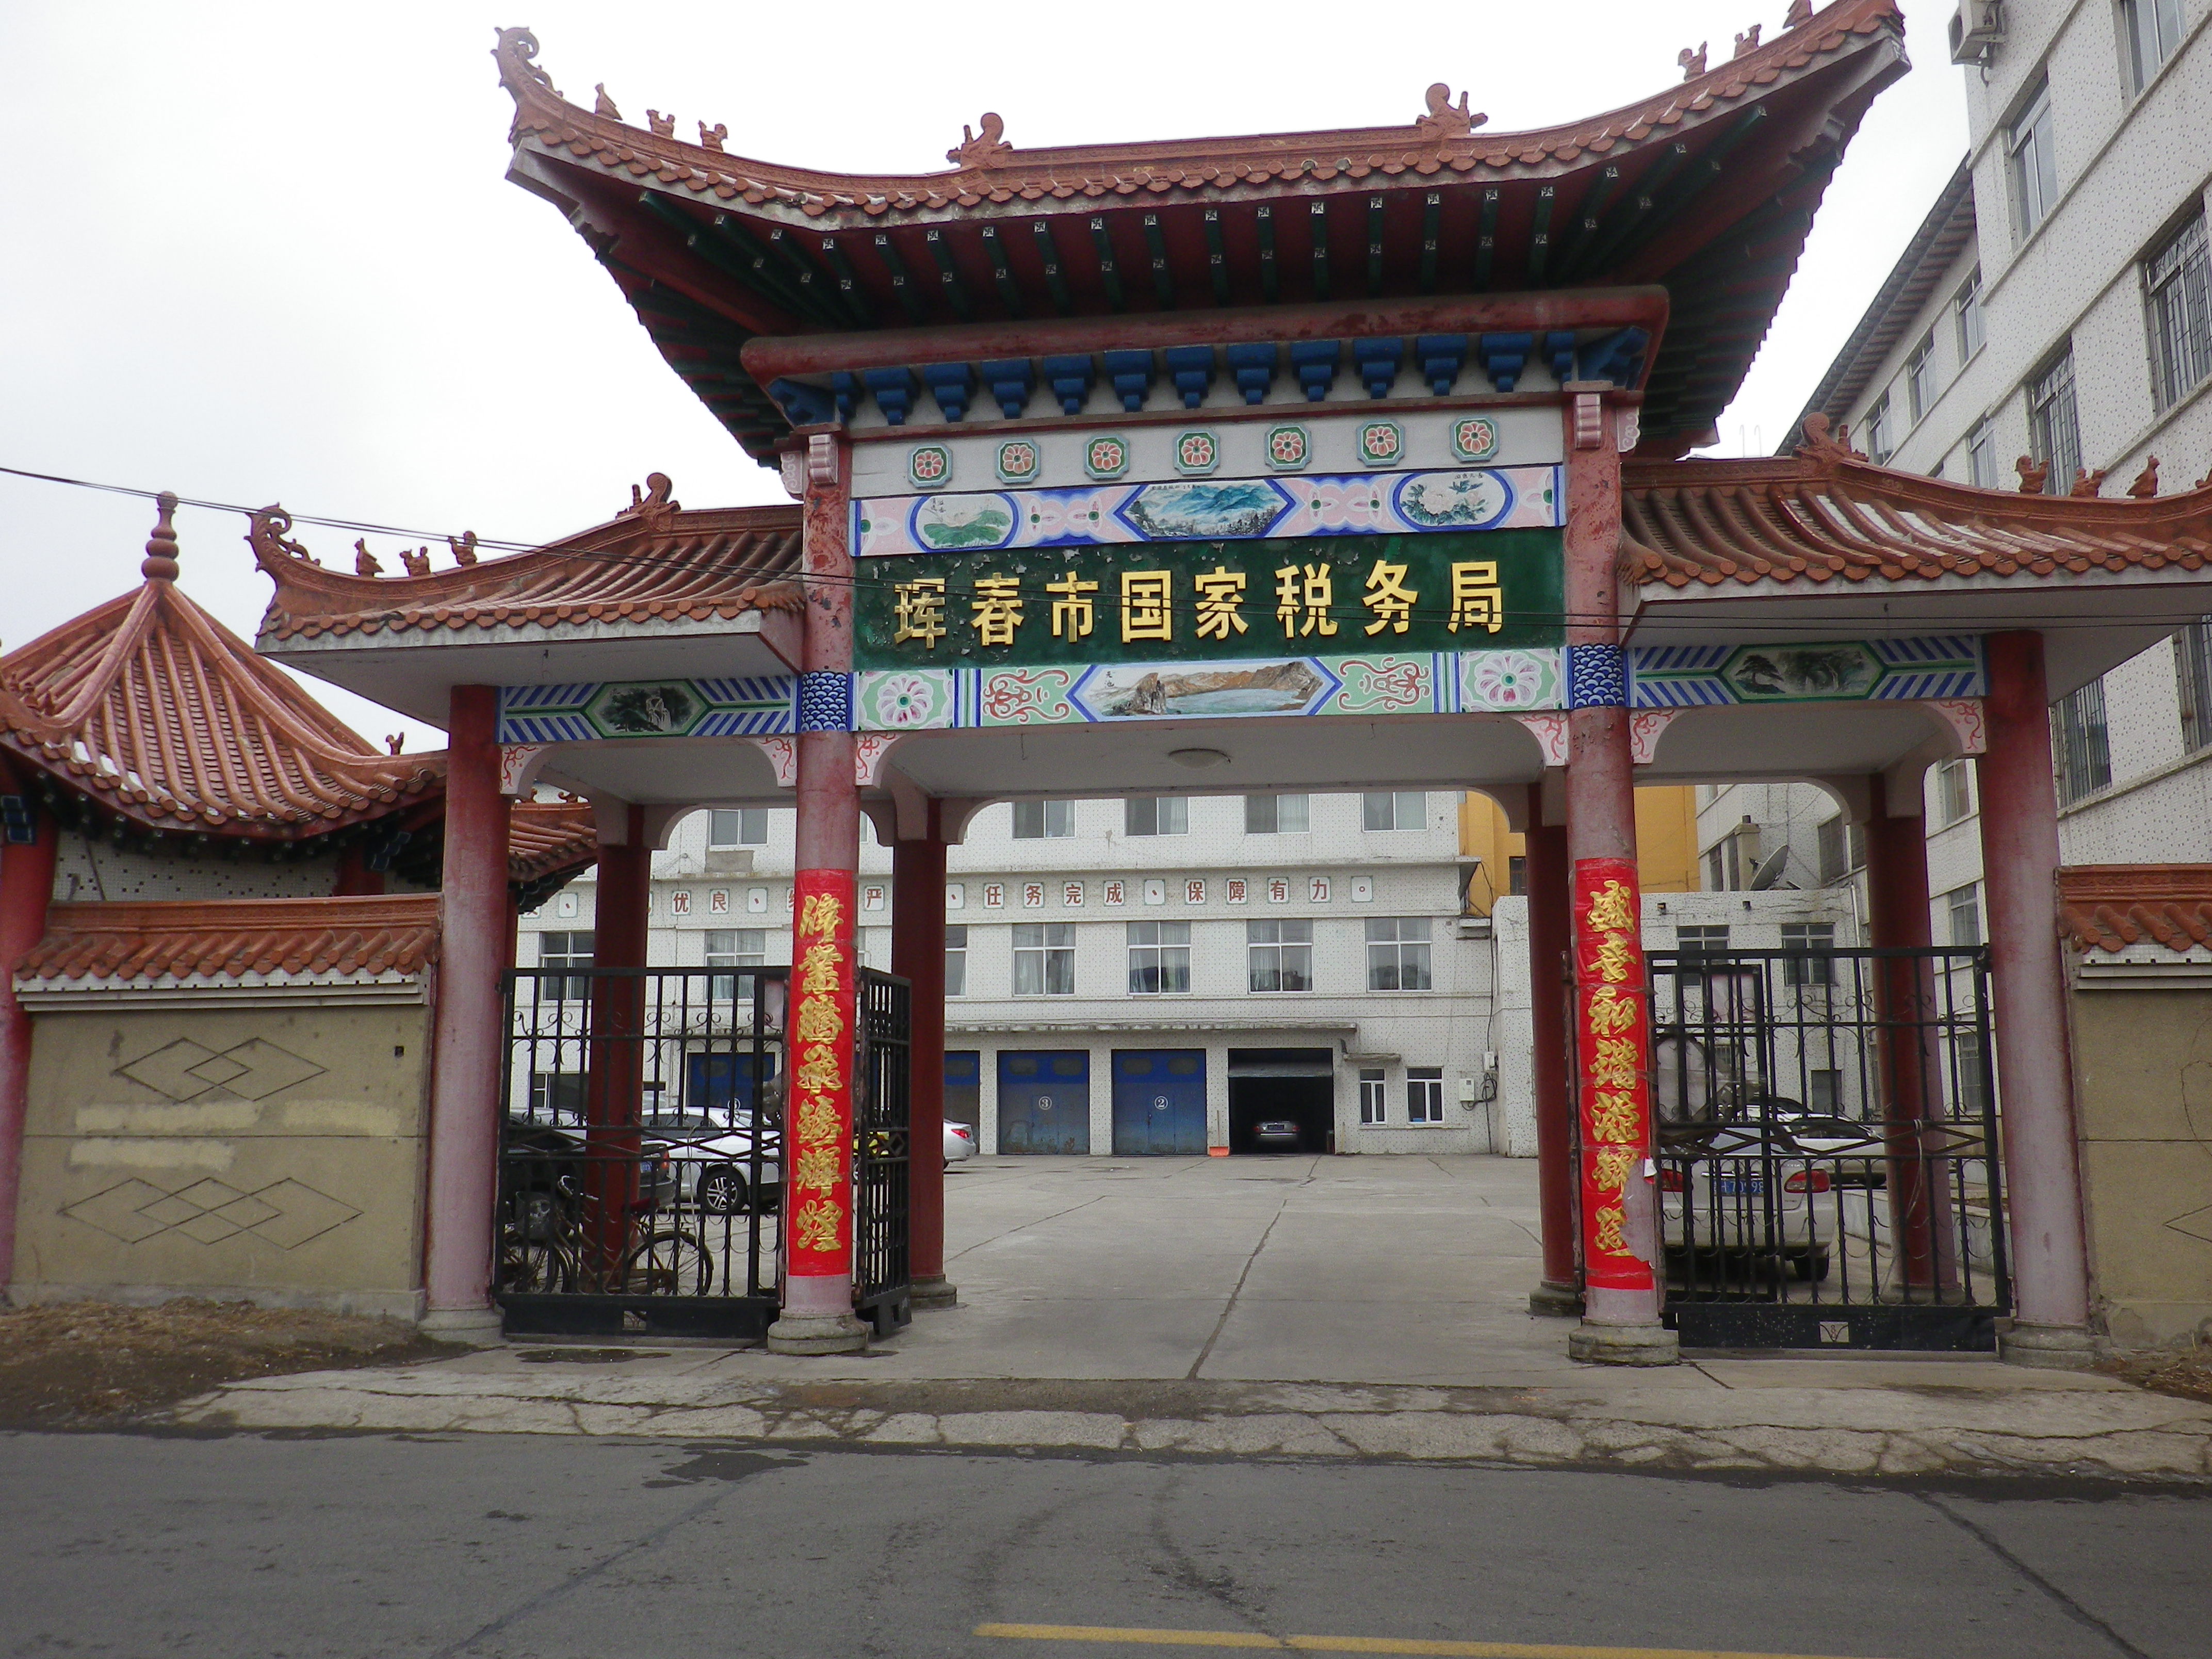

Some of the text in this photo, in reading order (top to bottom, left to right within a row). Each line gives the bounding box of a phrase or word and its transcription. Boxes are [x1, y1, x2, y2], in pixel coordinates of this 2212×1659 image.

[893, 559, 1502, 649] 珲春市国家税务局
